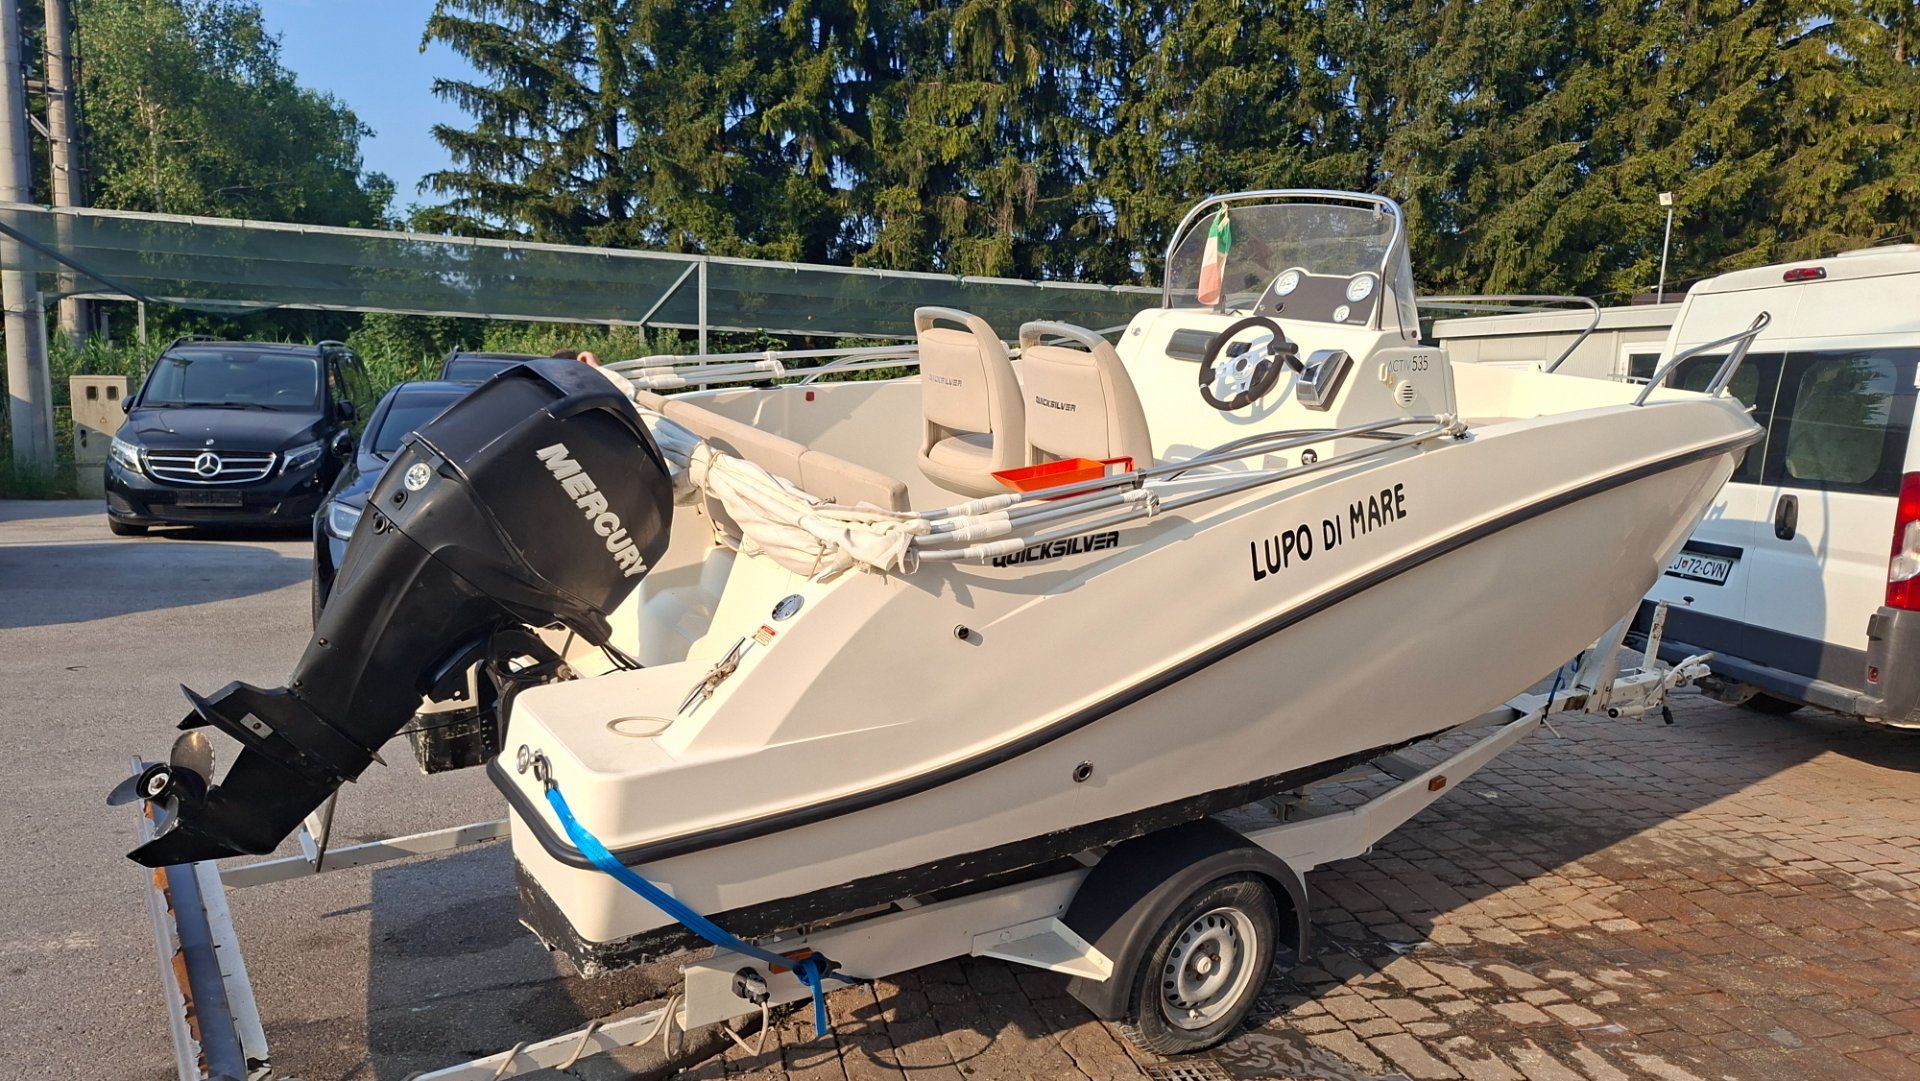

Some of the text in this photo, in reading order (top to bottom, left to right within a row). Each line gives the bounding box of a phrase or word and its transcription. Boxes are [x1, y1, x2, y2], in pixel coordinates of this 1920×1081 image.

[1411, 355, 1429, 372] 535
[1035, 395, 1077, 413] QUICKSILVER
[536, 442, 648, 578] MERCURY
[1250, 482, 1407, 581] LUPO DI MARE
